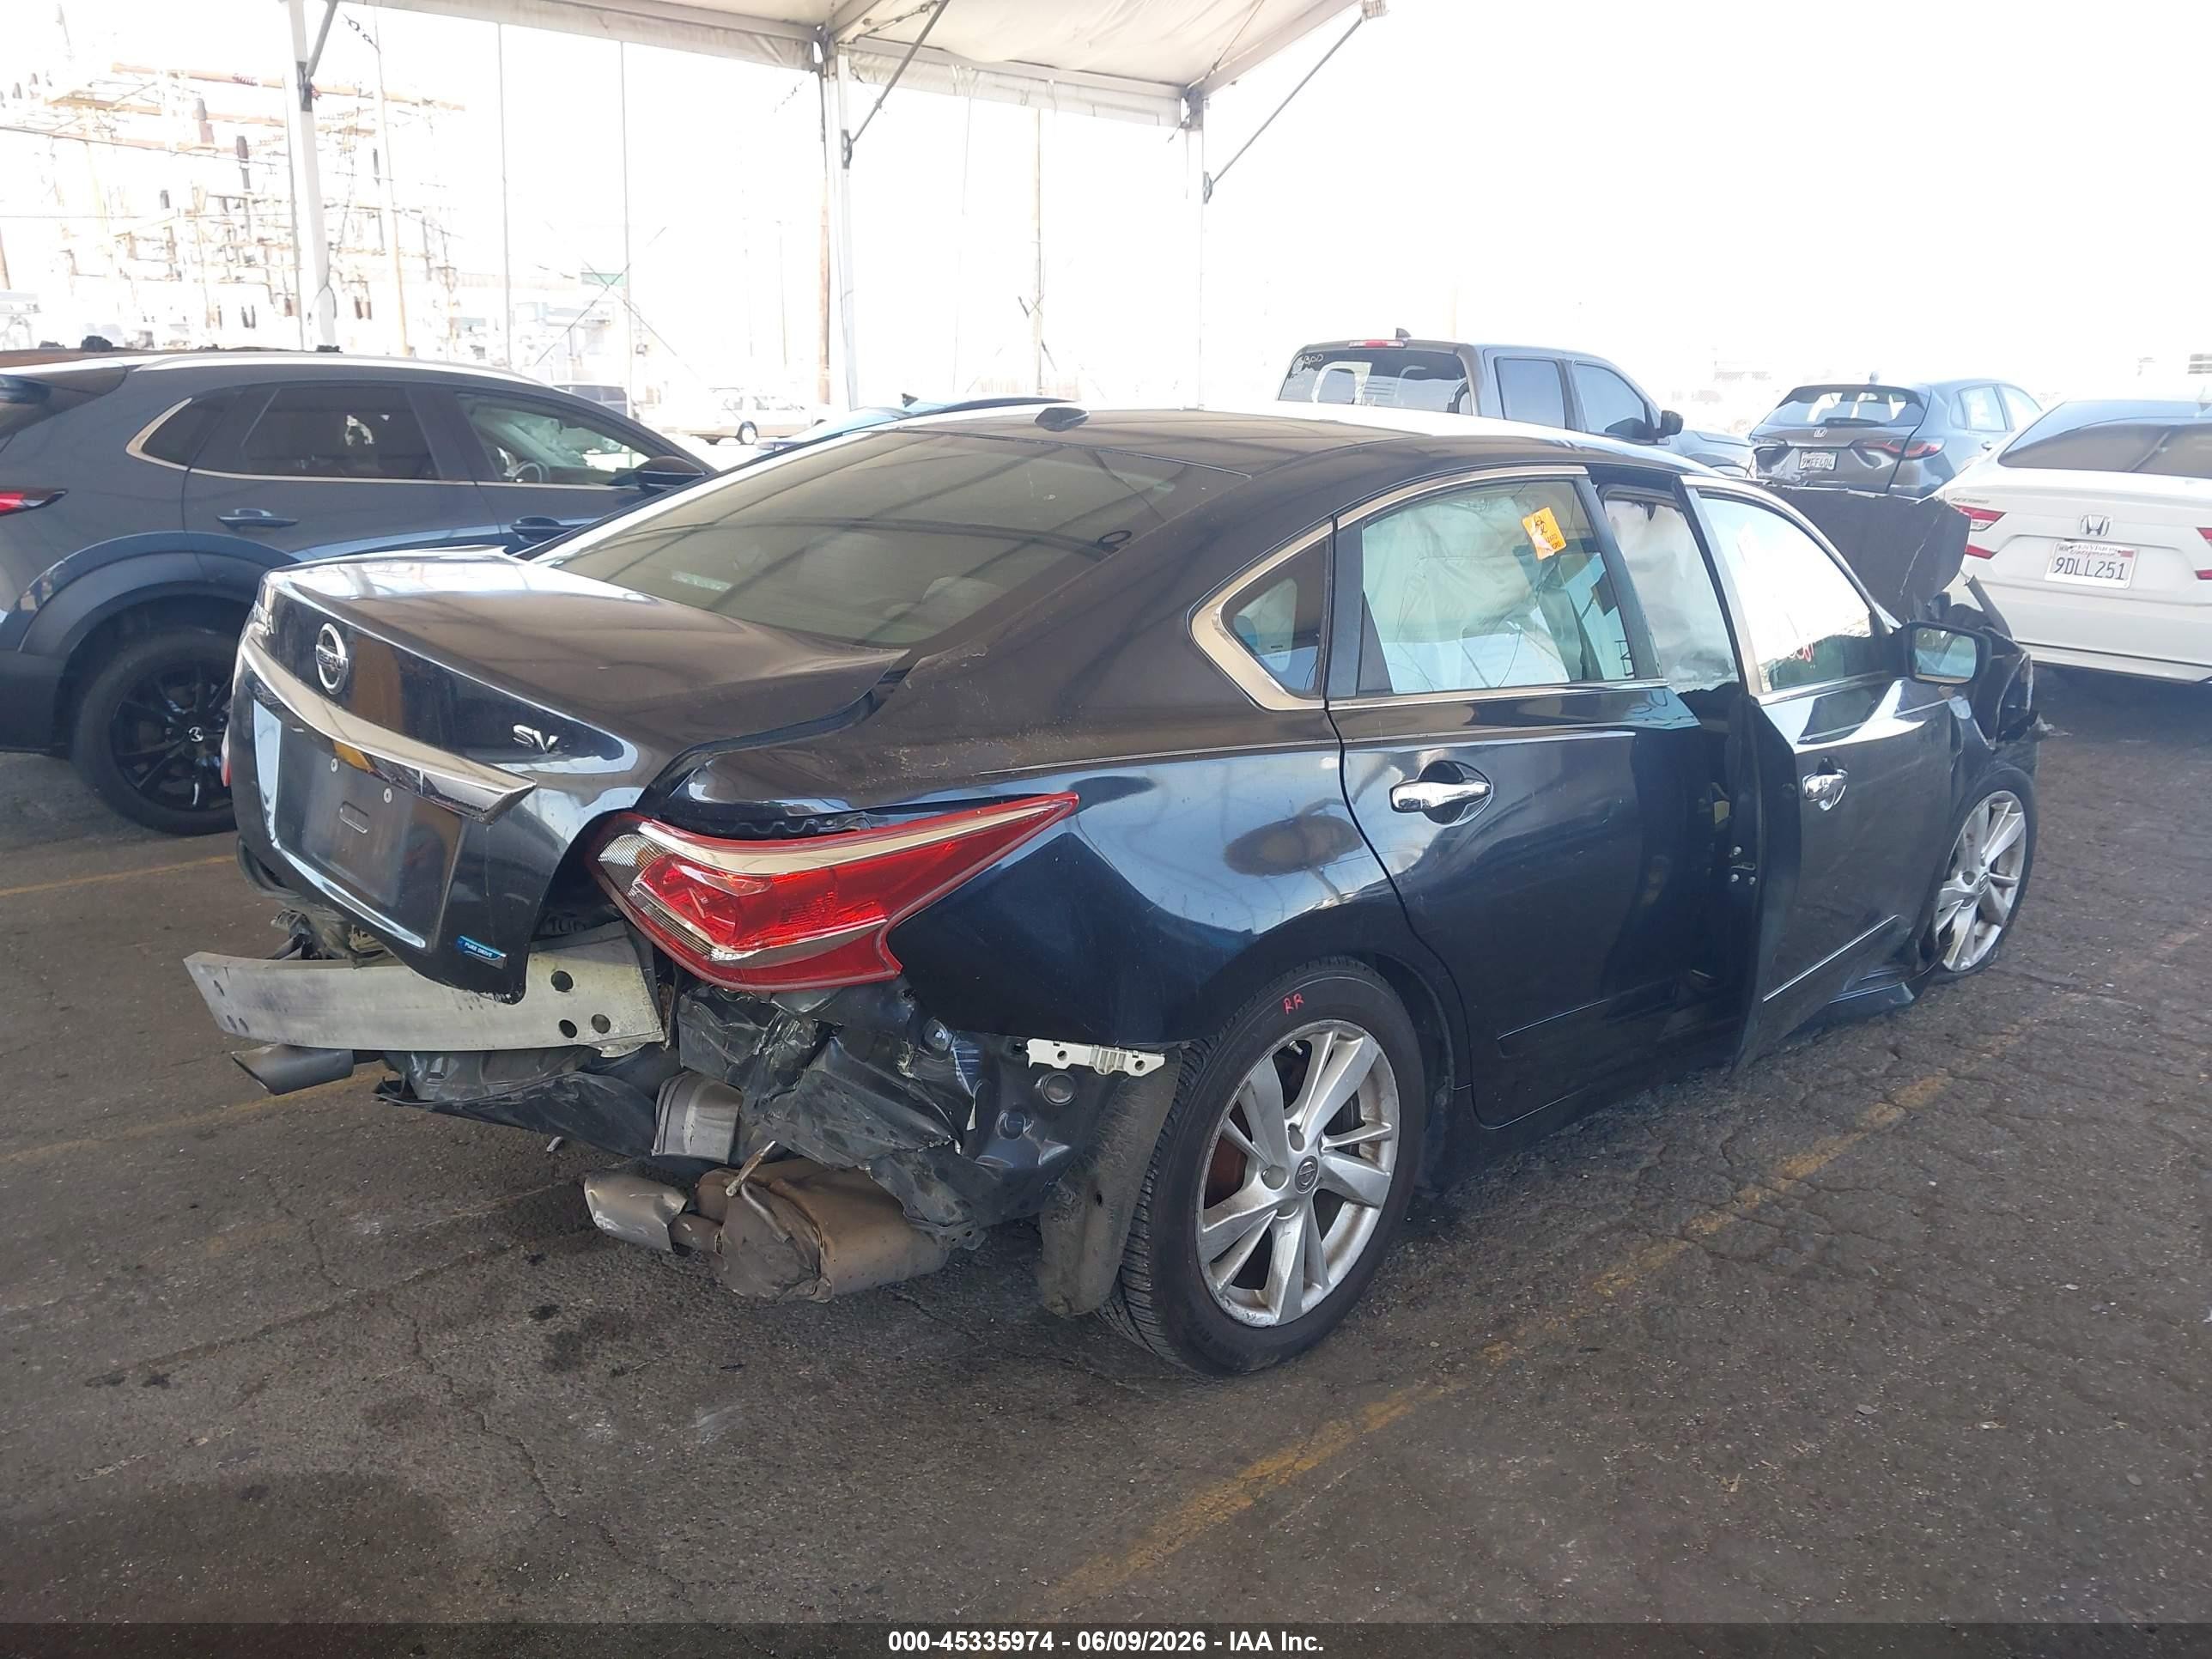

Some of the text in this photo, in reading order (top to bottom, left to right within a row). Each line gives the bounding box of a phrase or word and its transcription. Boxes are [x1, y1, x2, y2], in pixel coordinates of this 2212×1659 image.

[2054, 556, 2124, 580] 9DLL251
[513, 725, 559, 756] SV
[1284, 993, 1304, 1015] RR
